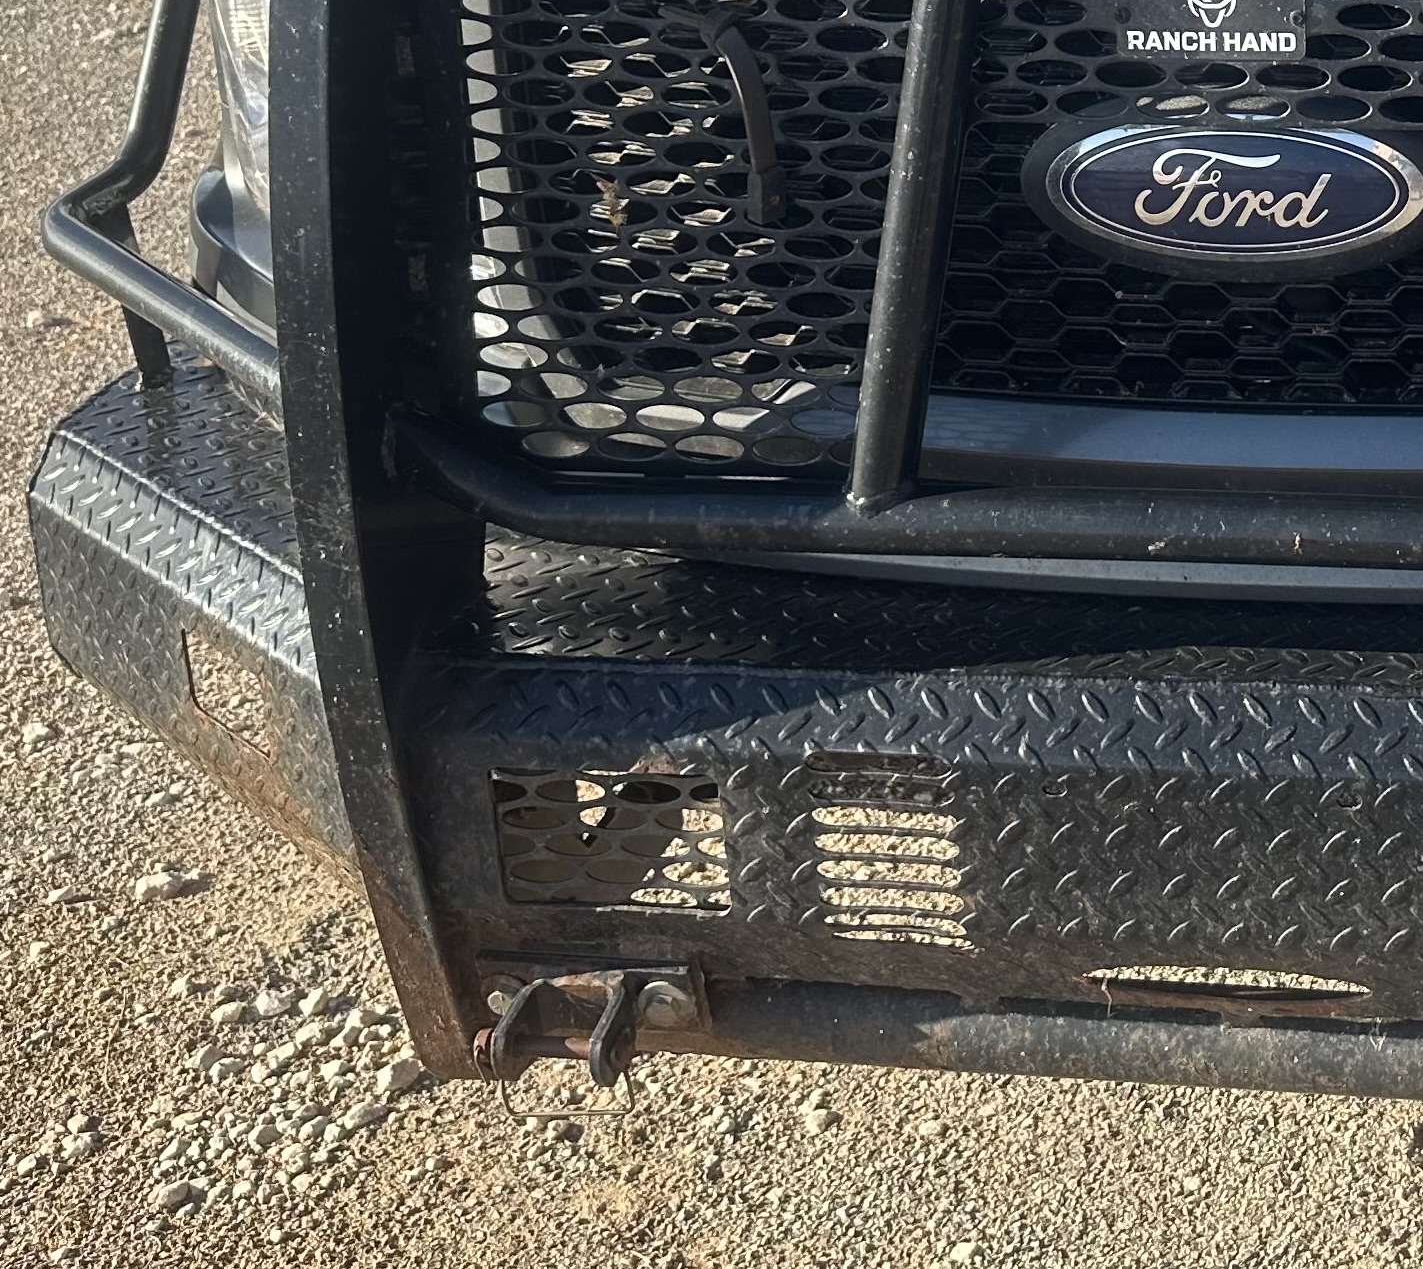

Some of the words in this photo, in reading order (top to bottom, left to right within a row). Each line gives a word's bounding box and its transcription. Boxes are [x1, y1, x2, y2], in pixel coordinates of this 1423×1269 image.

[1126, 30, 1217, 52] RANCH
[1222, 31, 1298, 52] HAND
[1134, 147, 1332, 229] Ford
